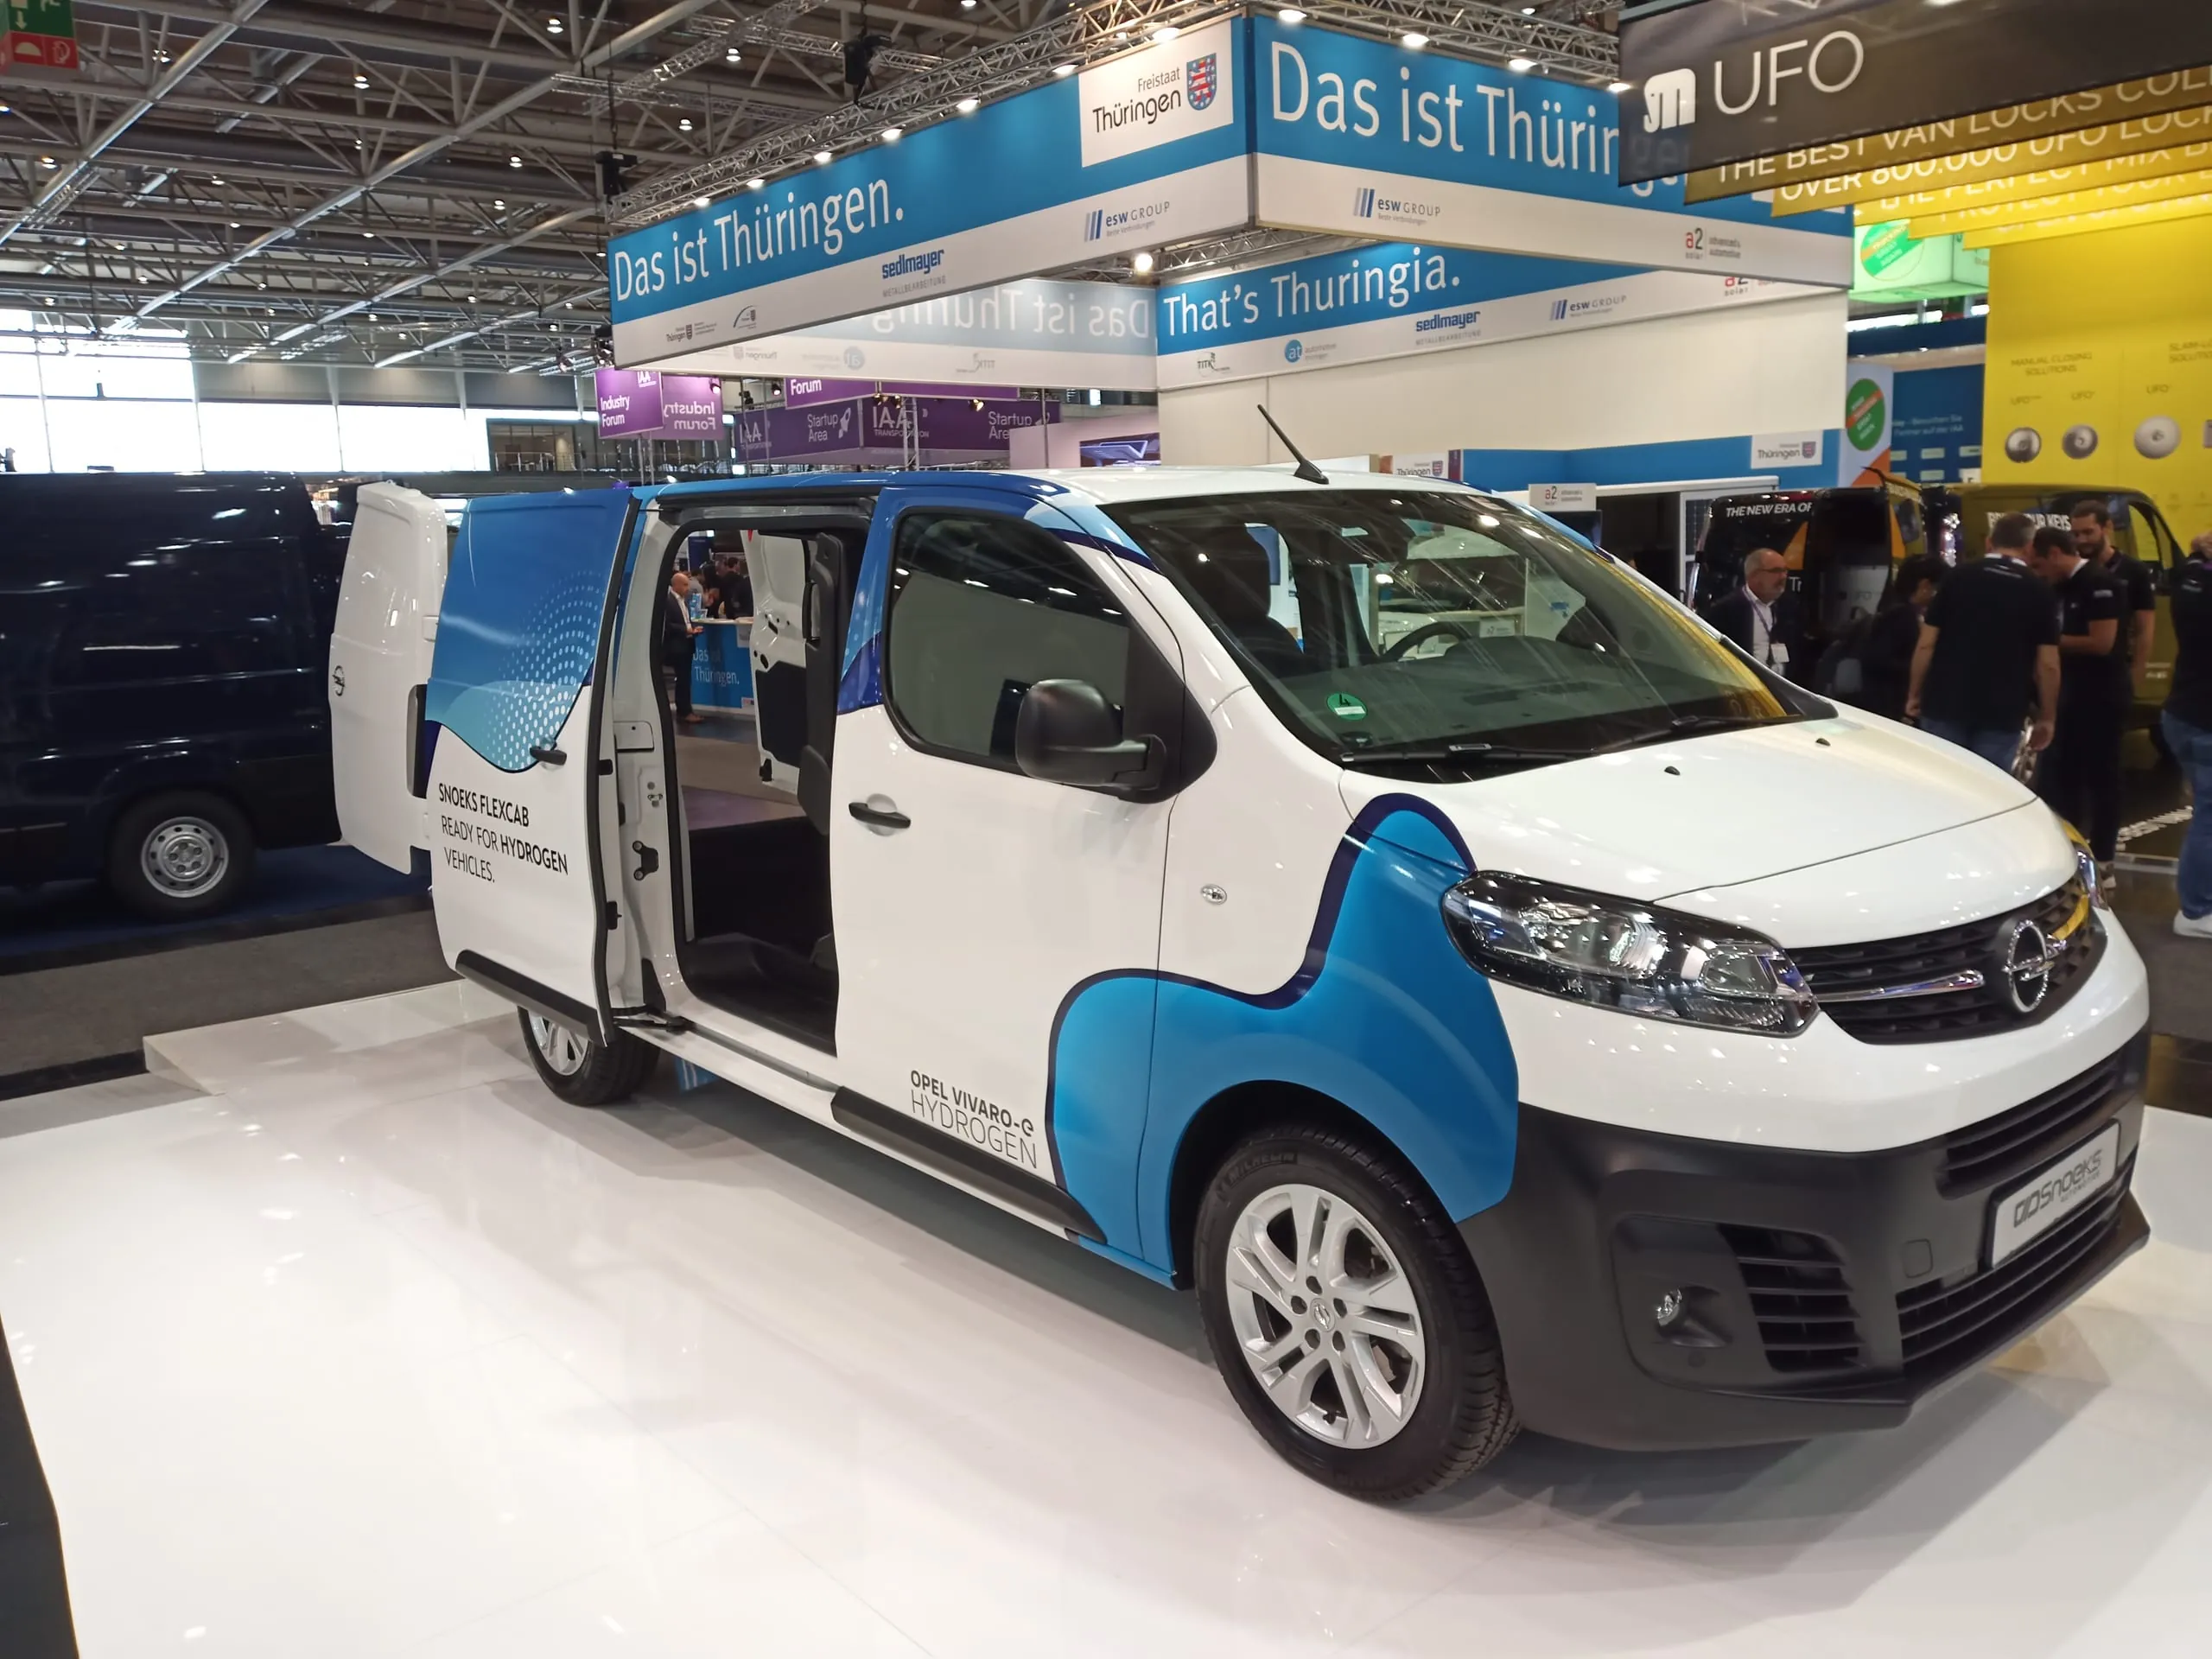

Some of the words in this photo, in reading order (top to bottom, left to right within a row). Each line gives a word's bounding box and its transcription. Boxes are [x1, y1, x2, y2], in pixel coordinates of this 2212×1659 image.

[1138, 67, 1180, 92] Freistaat
[1714, 30, 1864, 115] UFO
[1271, 41, 1380, 137] Das
[1399, 66, 1465, 152] ist
[1883, 119, 1955, 150] VAN
[1969, 91, 2102, 135] LOCKS
[2116, 66, 2212, 102] COL
[1092, 90, 1181, 133] Thüringen
[1780, 171, 1862, 201] OVER
[1106, 212, 1128, 227] esw
[1131, 201, 1170, 221] GROUP
[1377, 199, 1401, 212] esw
[1403, 202, 1440, 217] GROUP
[614, 251, 664, 302] Das
[672, 231, 709, 284] ist
[714, 179, 904, 271] Thüringen.
[1686, 227, 1704, 250] a2
[882, 249, 945, 279] sedlmayer
[1271, 246, 1460, 318] Thuringia.
[1569, 301, 1590, 312] esw
[1592, 295, 1628, 308] GROUP
[1415, 310, 1481, 332] sedlmayer
[791, 378, 822, 396] Forum
[601, 395, 630, 410] Industry
[602, 413, 625, 427] Forum
[807, 413, 838, 429] Startup
[988, 410, 1033, 428] Startup
[808, 429, 828, 442] Area
[989, 427, 1009, 440] Are
[1758, 449, 1800, 460] Thüringen
[1726, 506, 1748, 518] THE
[1747, 503, 1774, 515] NEW
[1774, 502, 1796, 514] ERA
[695, 665, 740, 687] Thüringen.
[439, 782, 477, 812] SNOEKS
[480, 794, 530, 827] FLEXCAB
[442, 815, 473, 843] READY
[476, 827, 499, 851] FOR
[500, 834, 569, 875] HYDROGEN
[444, 847, 495, 883] VEHICLES.
[911, 1070, 949, 1101] OPEL
[912, 1089, 1037, 1169] HYDROGEN
